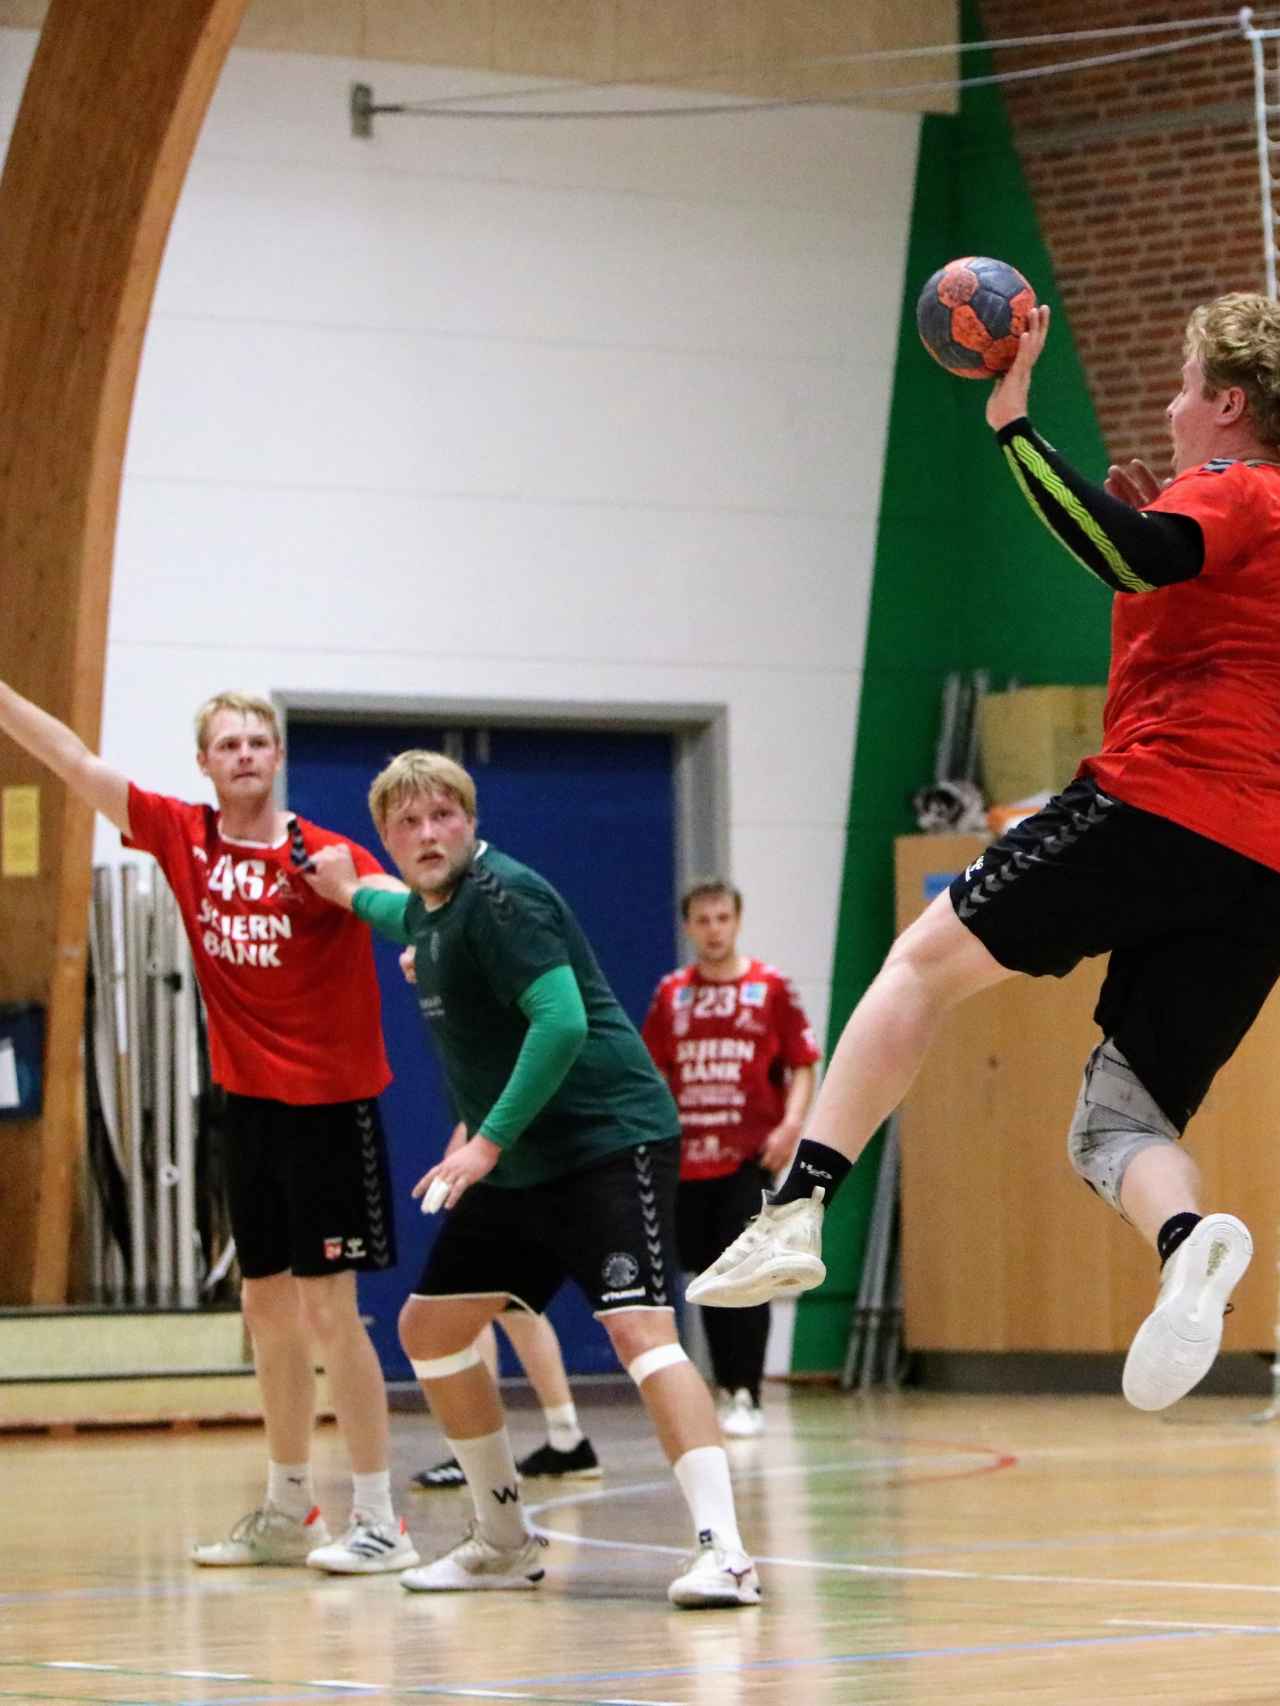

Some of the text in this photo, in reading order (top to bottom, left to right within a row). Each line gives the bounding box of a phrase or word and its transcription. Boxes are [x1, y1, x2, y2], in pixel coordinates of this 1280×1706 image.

[208, 853, 266, 901] 46
[203, 930, 282, 968] BANK
[691, 984, 738, 1019] 23
